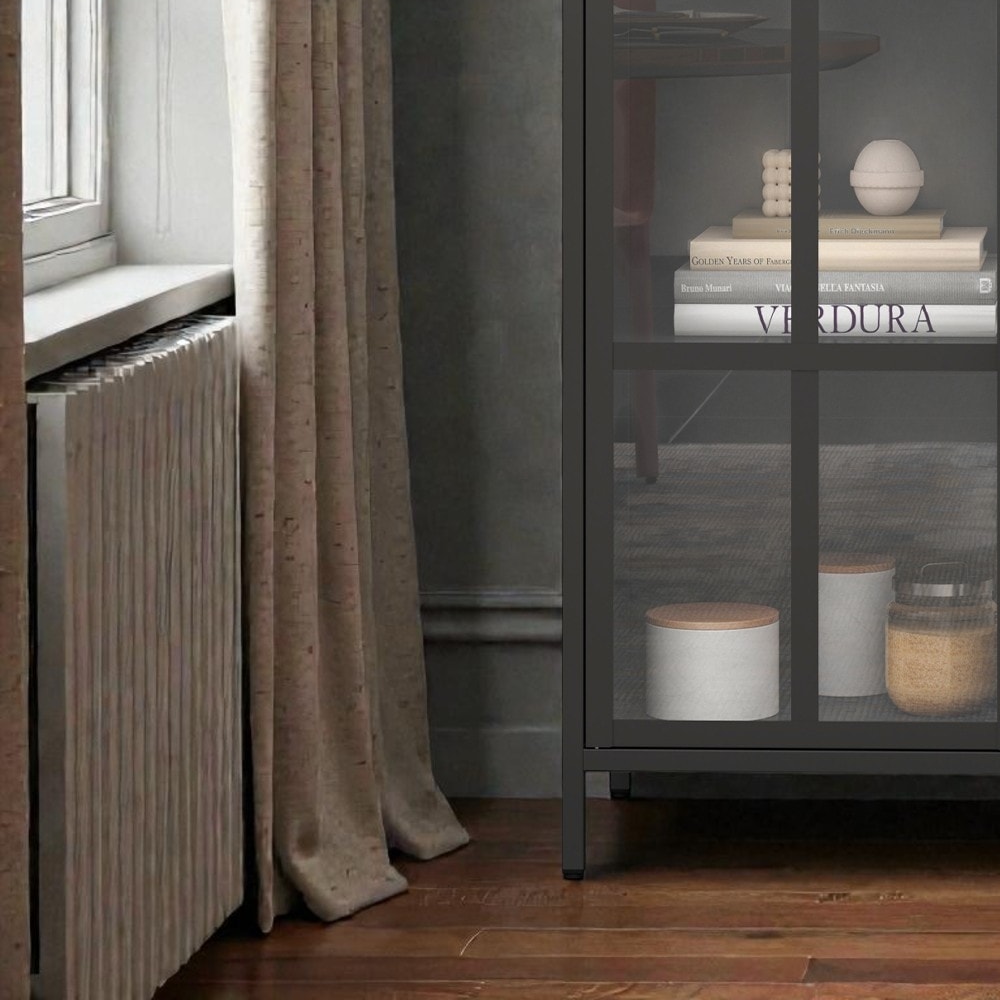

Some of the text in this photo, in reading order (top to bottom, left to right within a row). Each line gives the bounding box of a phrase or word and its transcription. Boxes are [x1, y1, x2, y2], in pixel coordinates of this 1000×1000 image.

[692, 256, 725, 266] GOLDEN
[726, 256, 752, 266] YEARS
[753, 257, 765, 265] OF
[681, 283, 733, 293] Bruno Munari
[818, 283, 885, 293] ELLA FANTASIA
